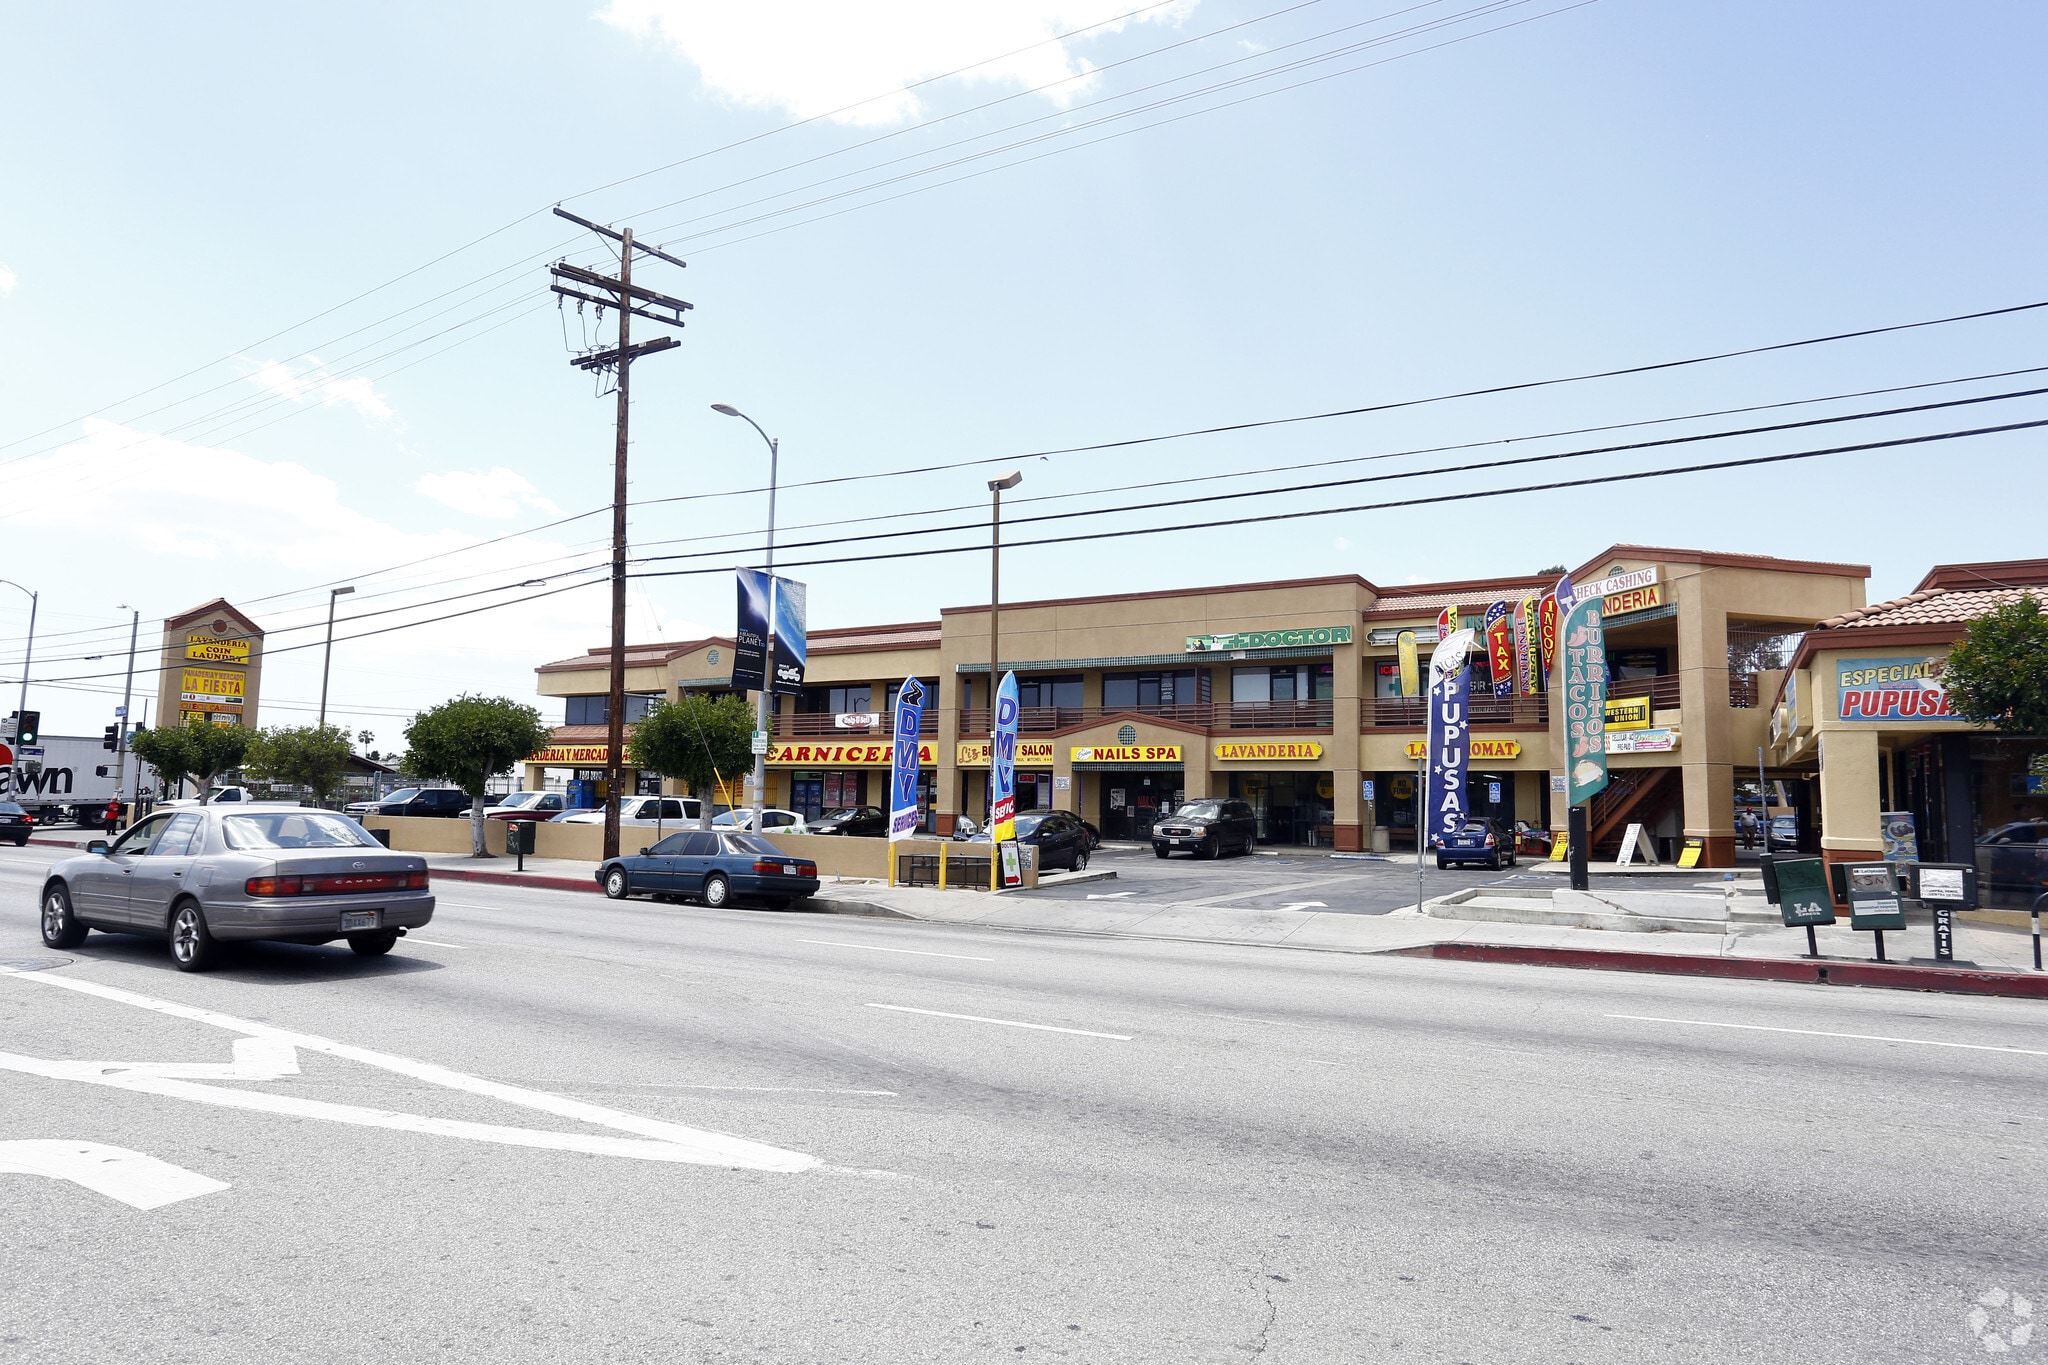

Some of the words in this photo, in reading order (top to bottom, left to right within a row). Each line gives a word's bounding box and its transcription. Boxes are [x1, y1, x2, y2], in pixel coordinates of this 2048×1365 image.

[1572, 582, 1602, 600] CHECK
[1605, 569, 1652, 593] CASHING
[1602, 588, 1657, 614] NDERIA
[190, 635, 247, 648] LAVANDERIA
[738, 636, 762, 647] PLANET
[1248, 627, 1349, 648] DOCTOR
[1543, 600, 1555, 664] INCOM
[206, 646, 231, 654] COIN
[1494, 631, 1509, 671] TAX
[1516, 616, 1530, 692] INSURANCE
[219, 671, 244, 681] MERCADO
[1586, 610, 1604, 753] BURRITOS
[1840, 662, 1934, 688] ESPECIAL
[185, 678, 198, 691] LA
[202, 680, 241, 694] FIESTA
[1568, 648, 1587, 739] TACOS
[1605, 706, 1639, 716] WESTERN
[1840, 689, 1956, 718] PUPUSA
[1614, 713, 1639, 722] UNION
[573, 748, 609, 761] MERCAD
[765, 746, 932, 762] CARNICERA
[898, 707, 919, 802] DMV
[958, 746, 981, 763] Liz
[1021, 745, 1053, 756] SALON
[996, 695, 1020, 795] DMV
[1093, 747, 1140, 760] NAILS
[1146, 747, 1177, 760] SPA
[1221, 744, 1314, 758] LAVANDERIA
[1410, 742, 1515, 758] LAOMAT
[1439, 681, 1462, 834] PUPUSAS
[1937, 910, 1949, 955] GRATIS
